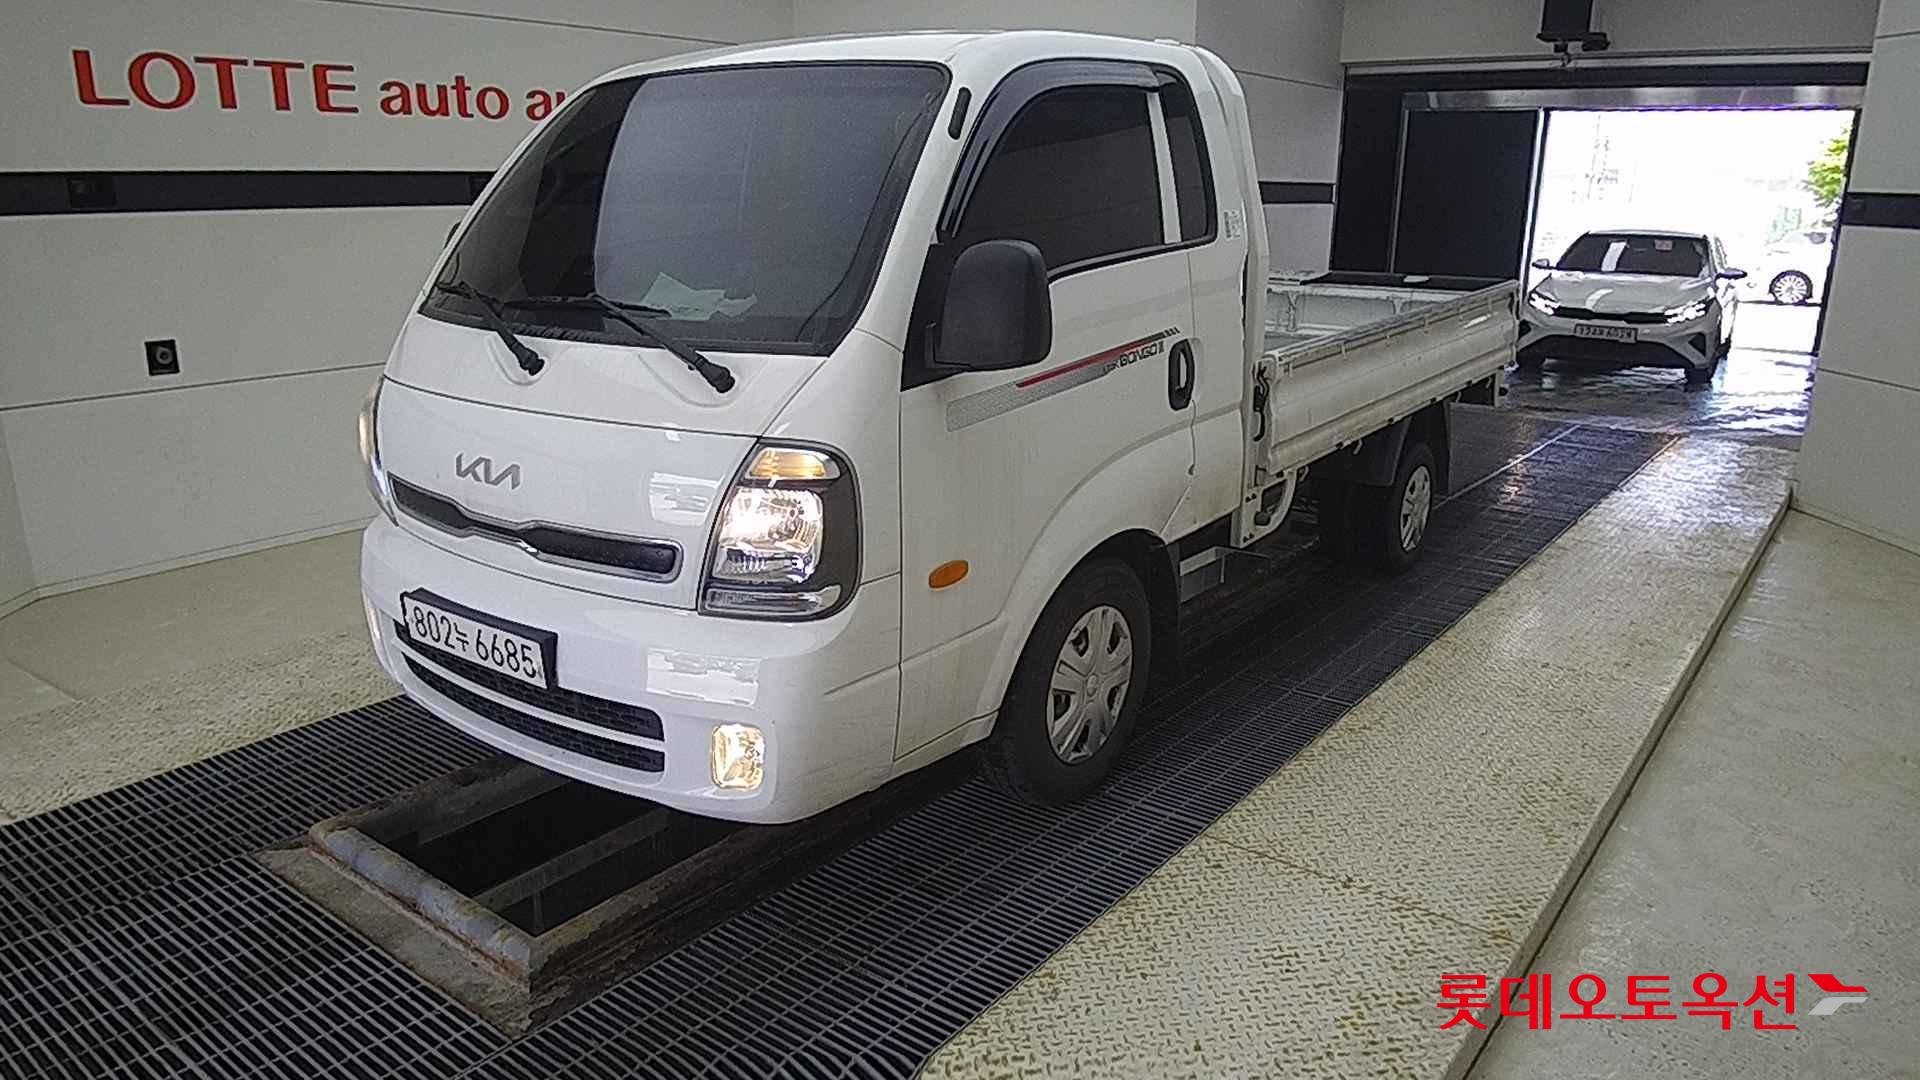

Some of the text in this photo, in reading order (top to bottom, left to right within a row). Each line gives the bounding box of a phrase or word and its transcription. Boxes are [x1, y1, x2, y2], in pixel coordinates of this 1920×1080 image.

[71, 49, 359, 114] LOTTE
[379, 75, 510, 120] auto
[456, 453, 521, 490] KIA
[475, 629, 537, 679] 6685
